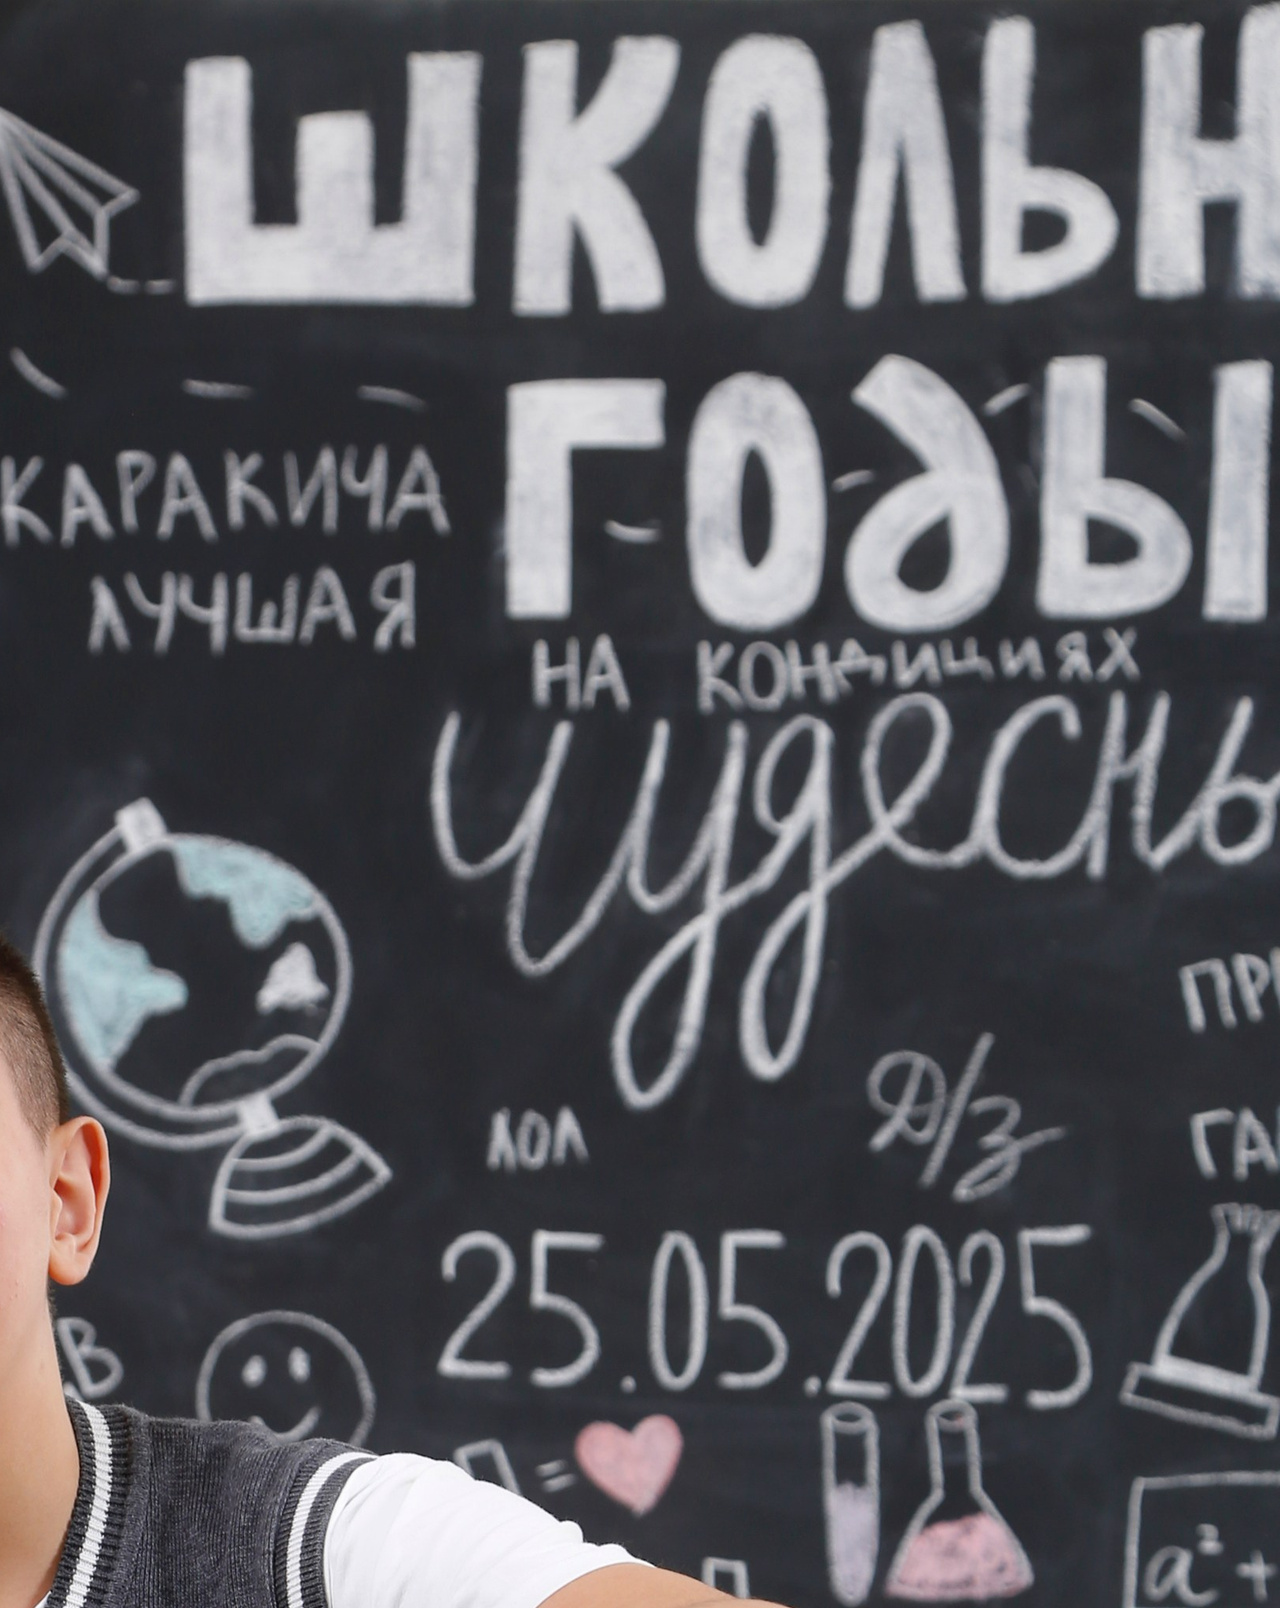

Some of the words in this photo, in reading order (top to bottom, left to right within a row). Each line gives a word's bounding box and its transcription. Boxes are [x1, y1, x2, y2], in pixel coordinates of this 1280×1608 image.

[0, 442, 452, 548] КАРАКИЧА
[87, 559, 417, 656] ЛУЧШАЯ
[531, 633, 631, 712] НА
[487, 1105, 589, 1170] ЛОЛ
[1189, 1105, 1280, 1182] ГА
[437, 1223, 1095, 1410] 25.05.2025
